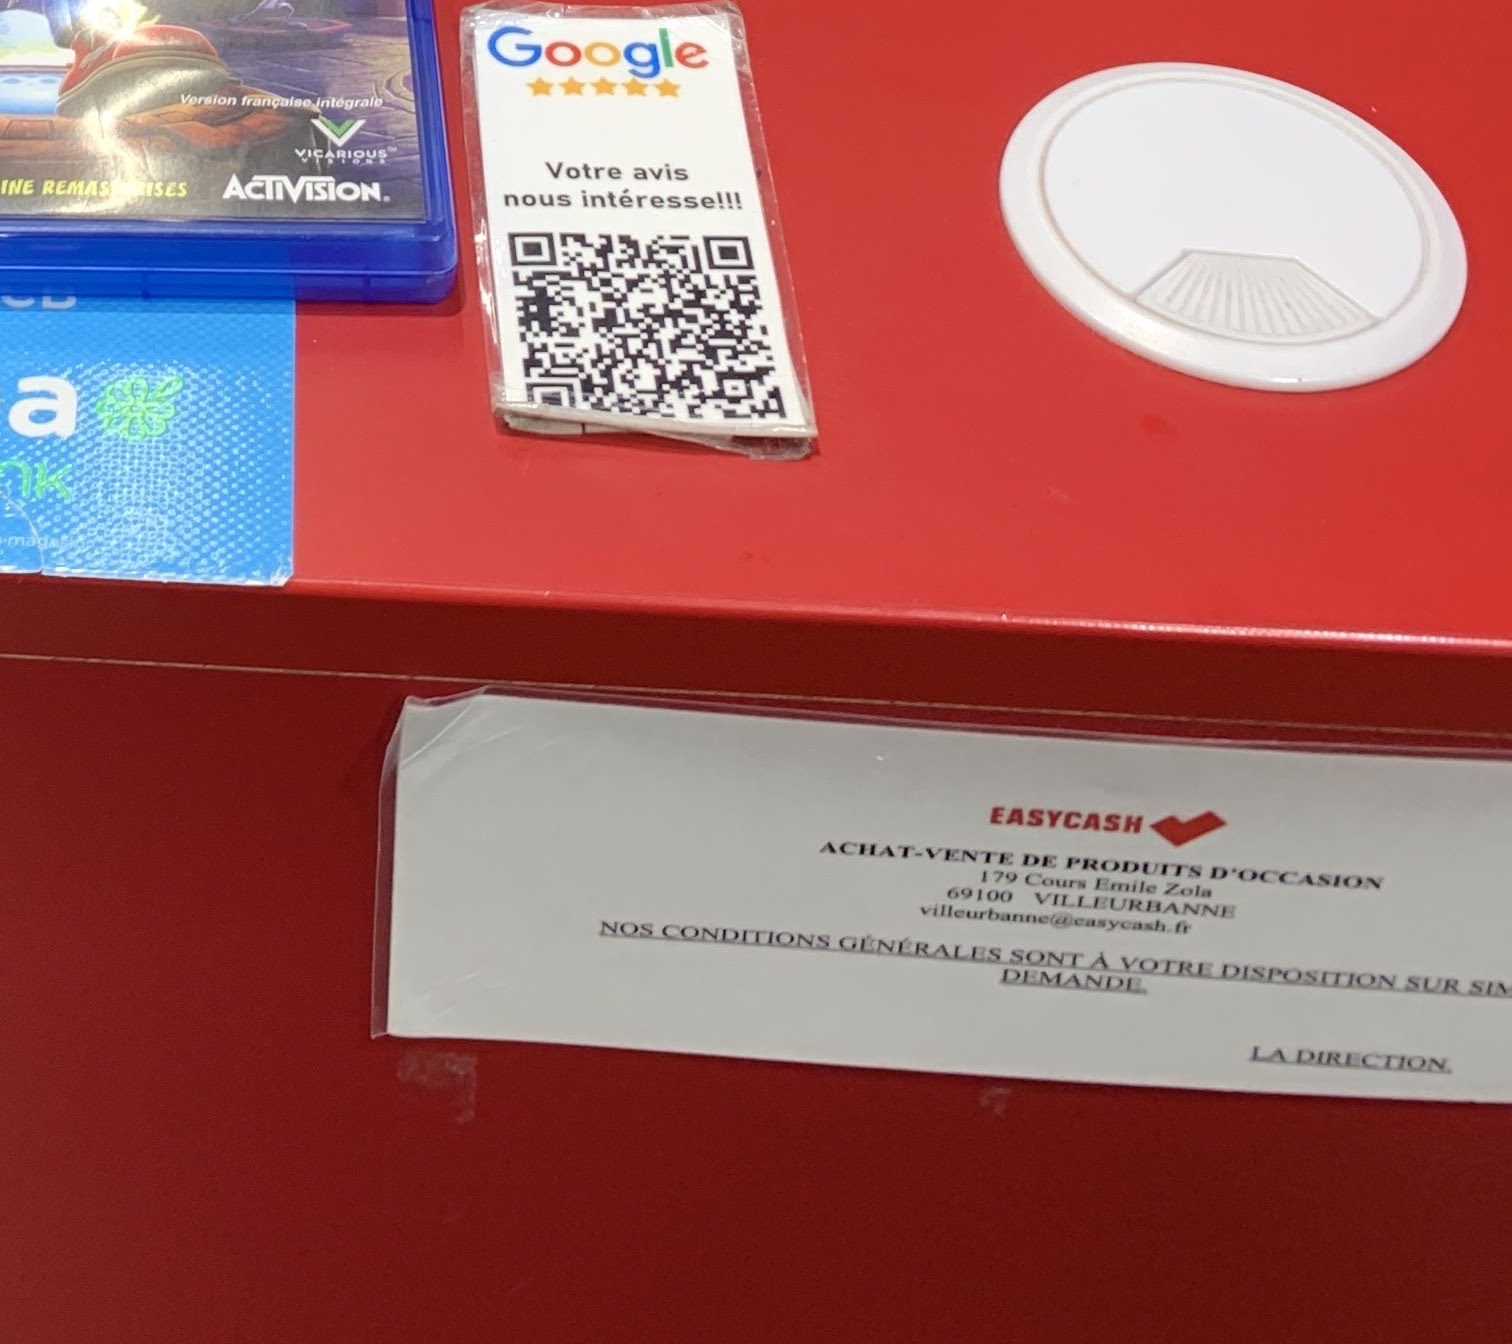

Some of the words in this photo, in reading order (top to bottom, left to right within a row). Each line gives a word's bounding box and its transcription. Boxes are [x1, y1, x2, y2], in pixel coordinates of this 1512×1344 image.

[487, 25, 710, 79] Google
[180, 93, 237, 107] Version
[241, 95, 313, 110] française
[315, 96, 384, 110] intégrale
[294, 149, 388, 158] VICARIOUS
[545, 162, 623, 181] Votre
[633, 163, 689, 181] avis
[41, 179, 188, 198] REMASISES
[222, 173, 382, 203] ACTIVISION
[503, 192, 572, 208] nous
[580, 188, 743, 210] intéresse!!!
[989, 806, 1144, 835] EASYCASH
[818, 840, 1014, 868] ACHAT-VENTE
[1021, 852, 1059, 871] DE
[1065, 855, 1203, 880] PRODUITS
[1210, 865, 1384, 892] D'OCCASION
[980, 870, 1018, 885] 179
[1024, 873, 1088, 892] Cours
[1094, 877, 1159, 896] Emile
[1164, 881, 1215, 899] Zola
[946, 887, 1014, 904] 69100
[1034, 891, 1238, 920] VILLEURBANNE
[918, 904, 1192, 937] villeurbanne@easycash.fr
[599, 919, 655, 939] NOS
[661, 923, 833, 949] CONDITIONS
[838, 935, 1003, 963] GÉNÉRALES
[1008, 948, 1085, 969] SONT
[1093, 950, 1111, 971] À
[1119, 955, 1215, 979] VOTRE
[1221, 962, 1397, 992] DISPOSITION
[1404, 975, 1461, 996] SUR
[1001, 968, 1148, 994] DEMANDE.
[1249, 1044, 1289, 1065] LA
[1296, 1048, 1454, 1075] DIRECTION.
